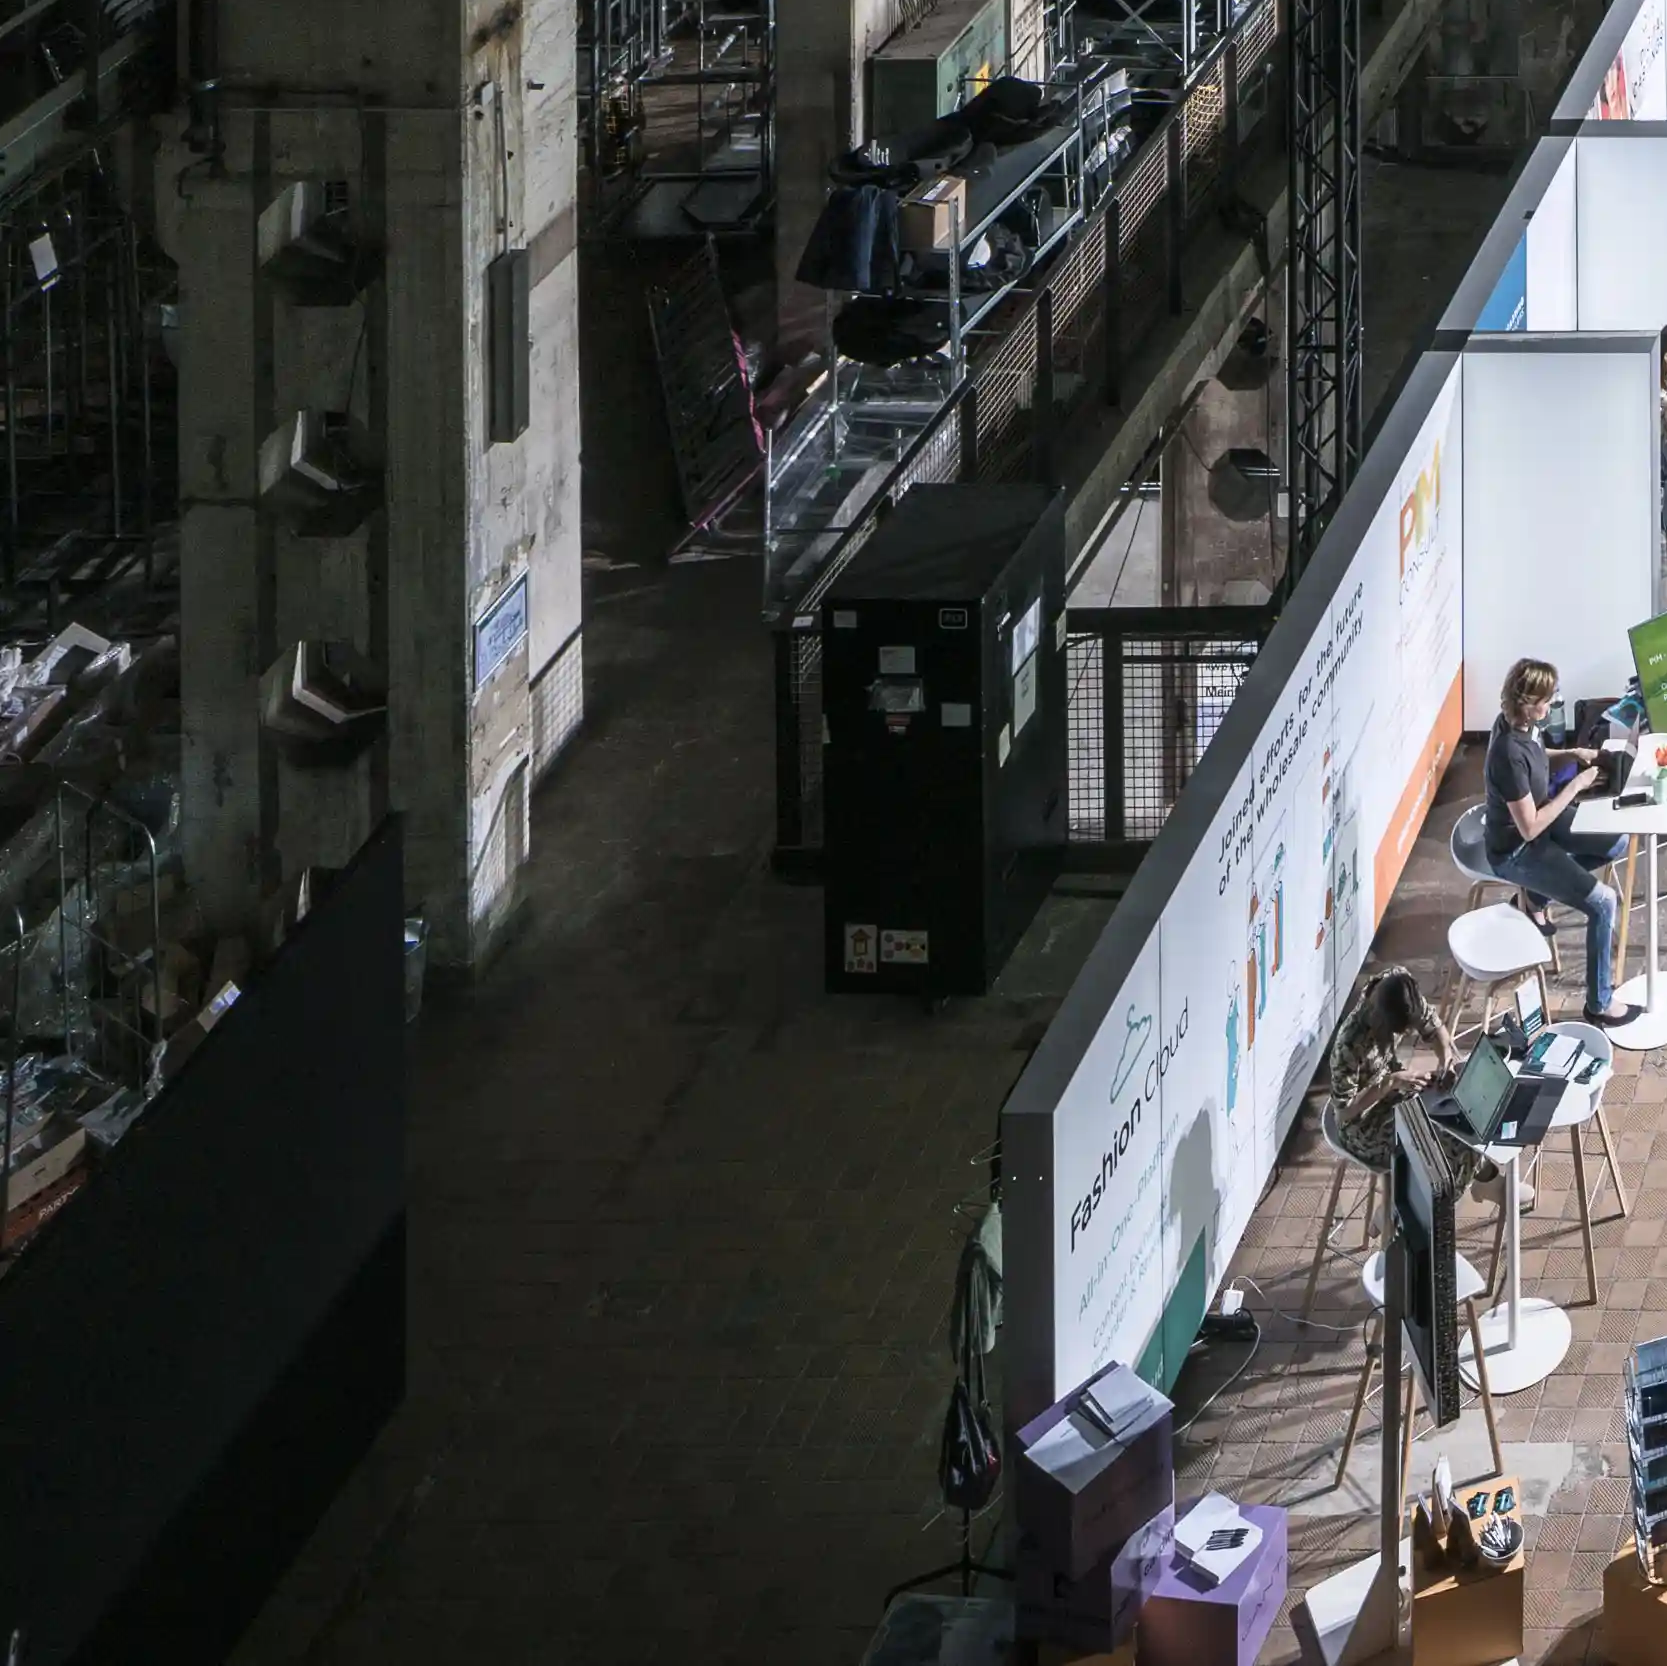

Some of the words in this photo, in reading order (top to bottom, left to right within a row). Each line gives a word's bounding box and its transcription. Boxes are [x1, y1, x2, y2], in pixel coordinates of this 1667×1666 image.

[1219, 780, 1255, 863] Joined
[1260, 712, 1295, 783] efforts
[1298, 683, 1313, 718] for
[1316, 640, 1333, 685] the
[1335, 581, 1363, 641] future
[1219, 863, 1232, 897] of
[1235, 820, 1254, 866] the
[1256, 720, 1308, 823] wholesale
[1312, 610, 1363, 719] community
[1070, 1097, 1141, 1254] Fashion
[1144, 996, 1188, 1103] Cloud
